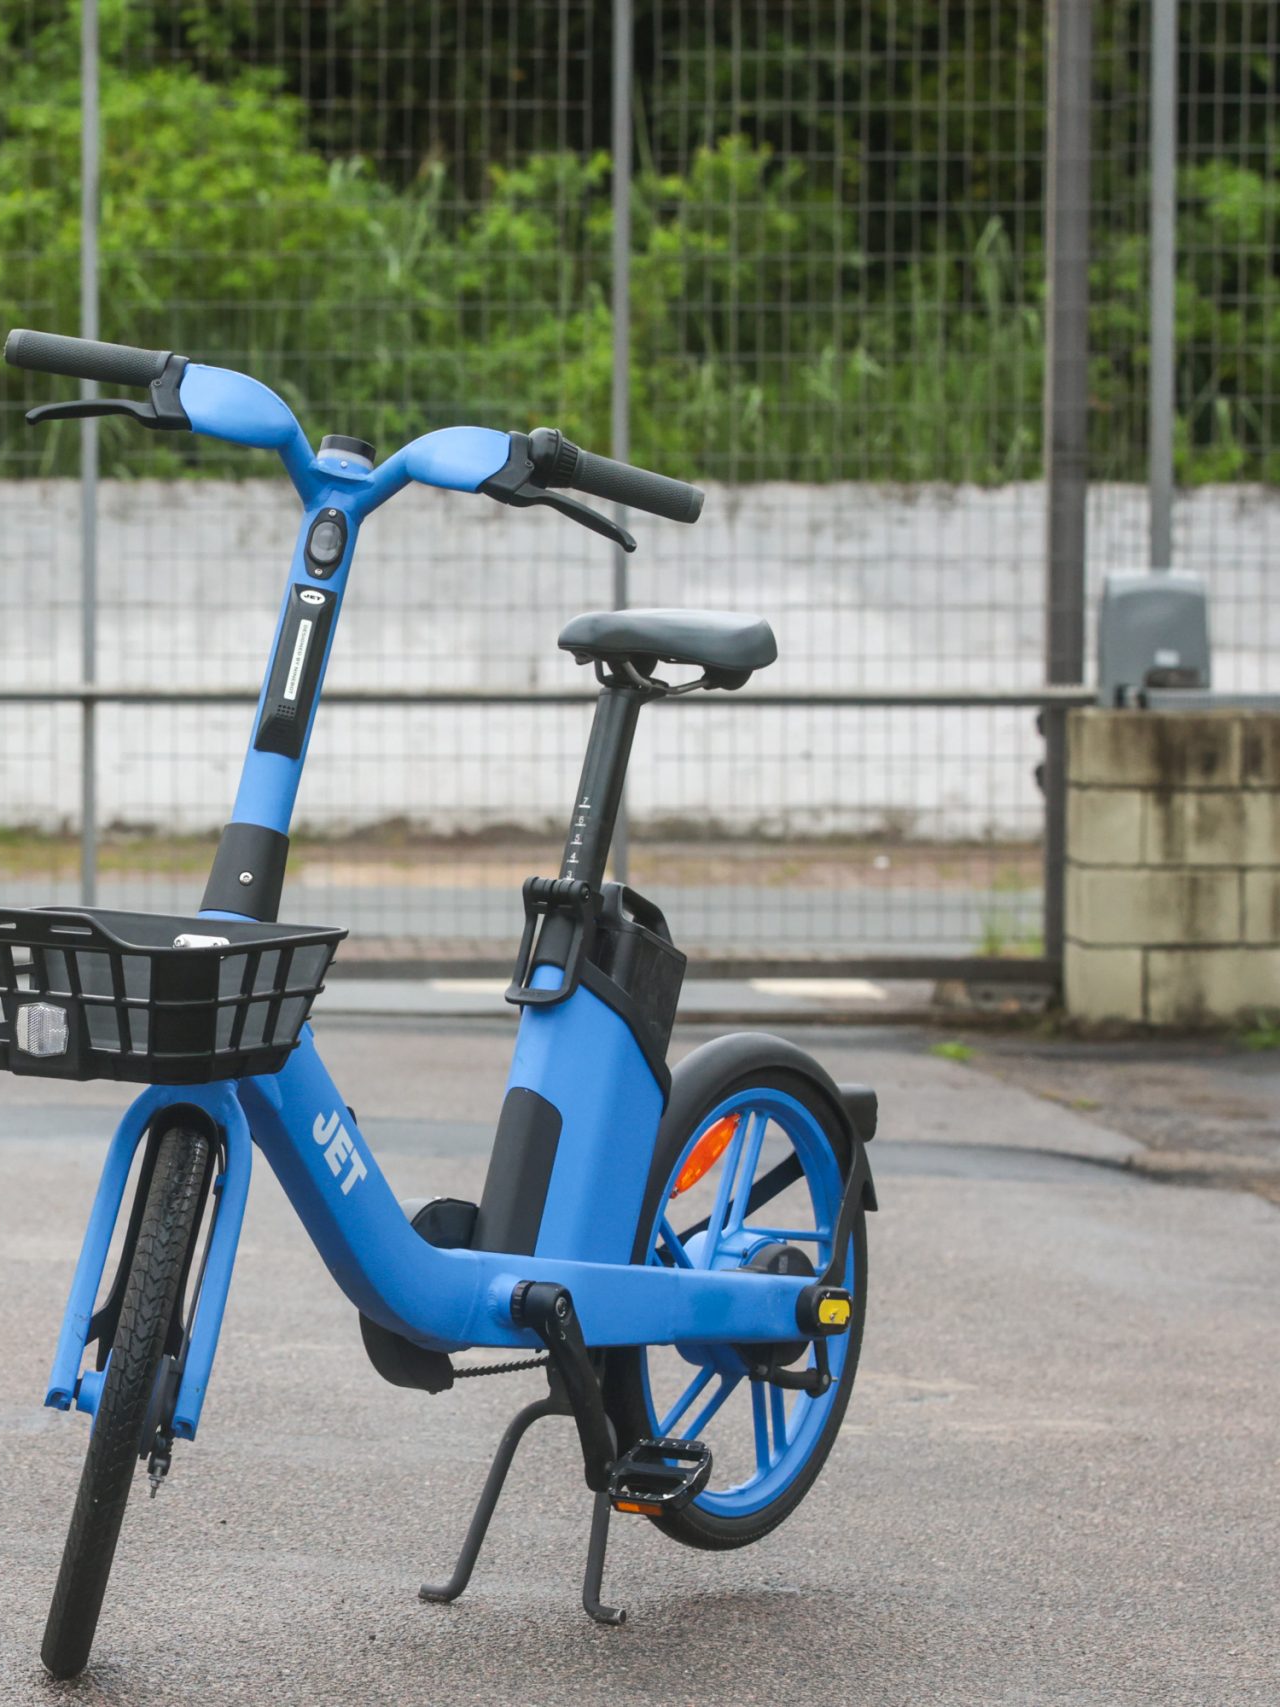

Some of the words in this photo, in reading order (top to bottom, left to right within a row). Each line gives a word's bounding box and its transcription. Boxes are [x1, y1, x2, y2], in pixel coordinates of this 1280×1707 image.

[303, 593, 322, 601] JET
[298, 624, 308, 656] DESIGNED
[288, 666, 299, 694] NINEBOT
[312, 1109, 368, 1196] JET
